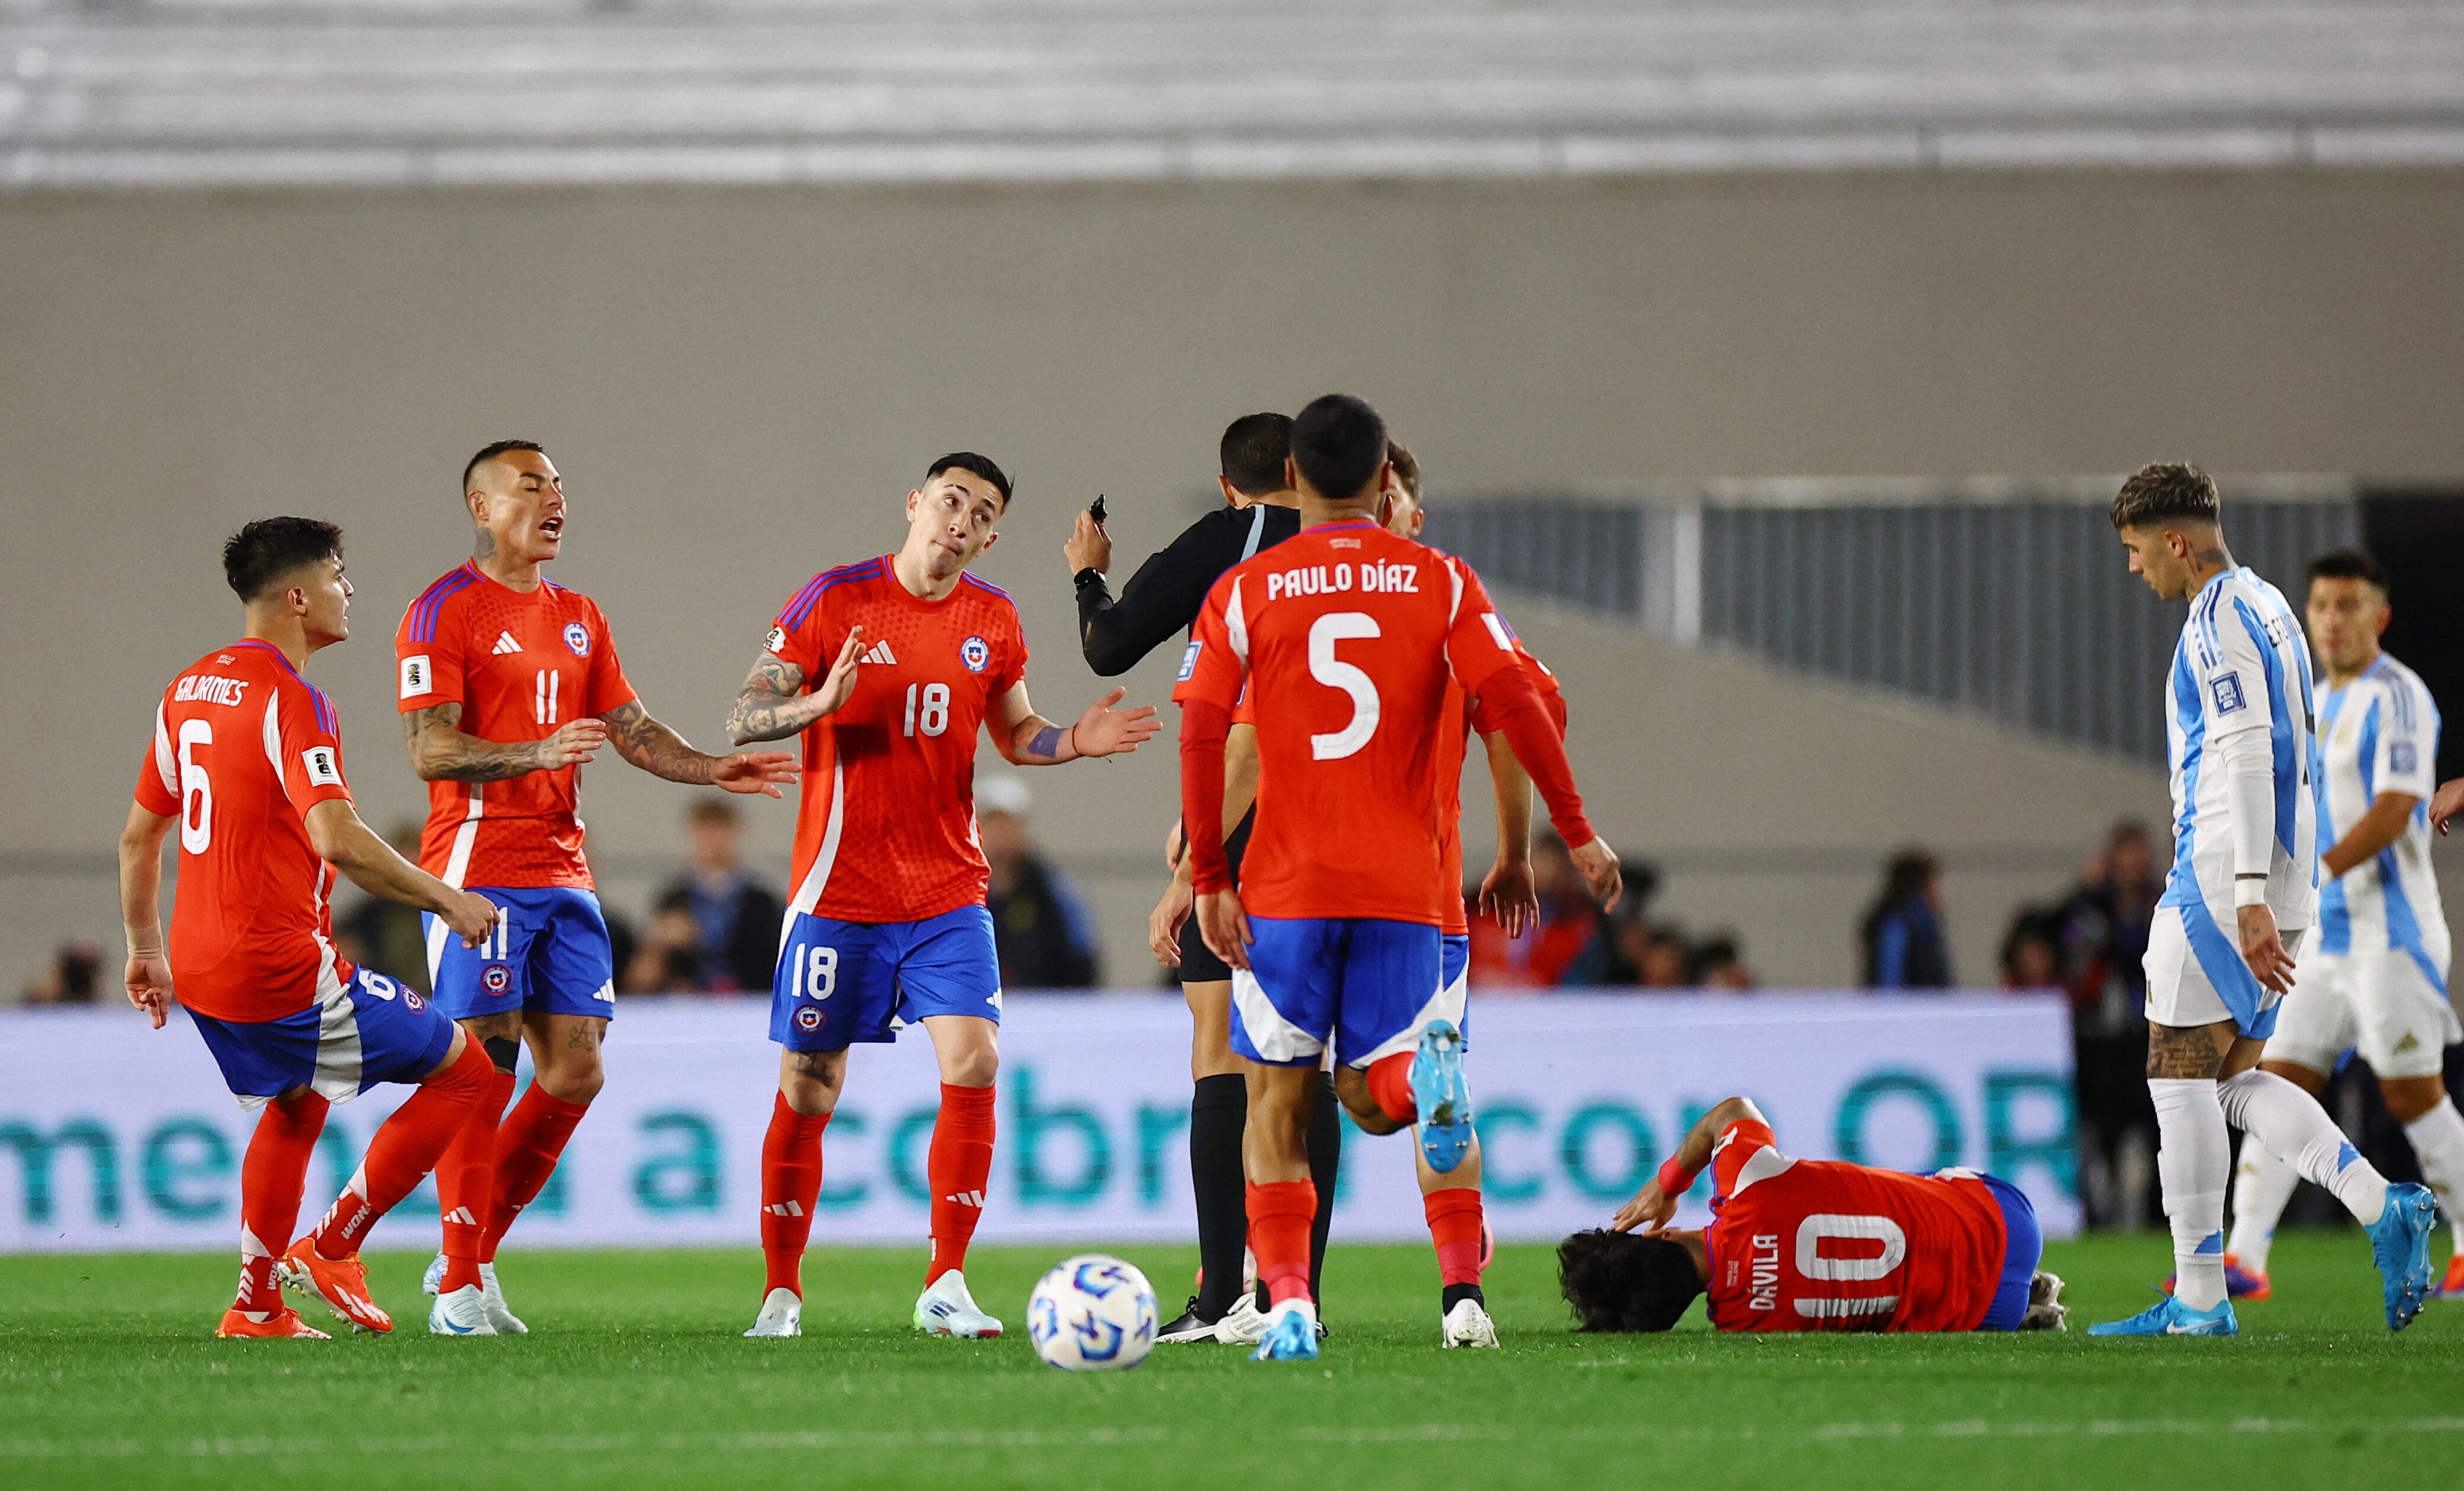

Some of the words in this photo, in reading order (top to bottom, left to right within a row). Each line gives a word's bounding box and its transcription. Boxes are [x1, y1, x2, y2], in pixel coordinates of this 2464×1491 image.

[1267, 563, 1353, 601] PAULO
[1361, 558, 1419, 593] DÍAZ
[174, 674, 249, 706] GALDAMES
[536, 670, 558, 725] 11
[904, 683, 950, 737] 18
[1308, 612, 1382, 761] 5
[177, 719, 213, 854] 6
[358, 971, 396, 1001] 6
[792, 943, 839, 1000] 18
[634, 1110, 718, 1214] a
[1747, 1235, 1778, 1310] DÁVILA
[1794, 1214, 1906, 1318] 10
